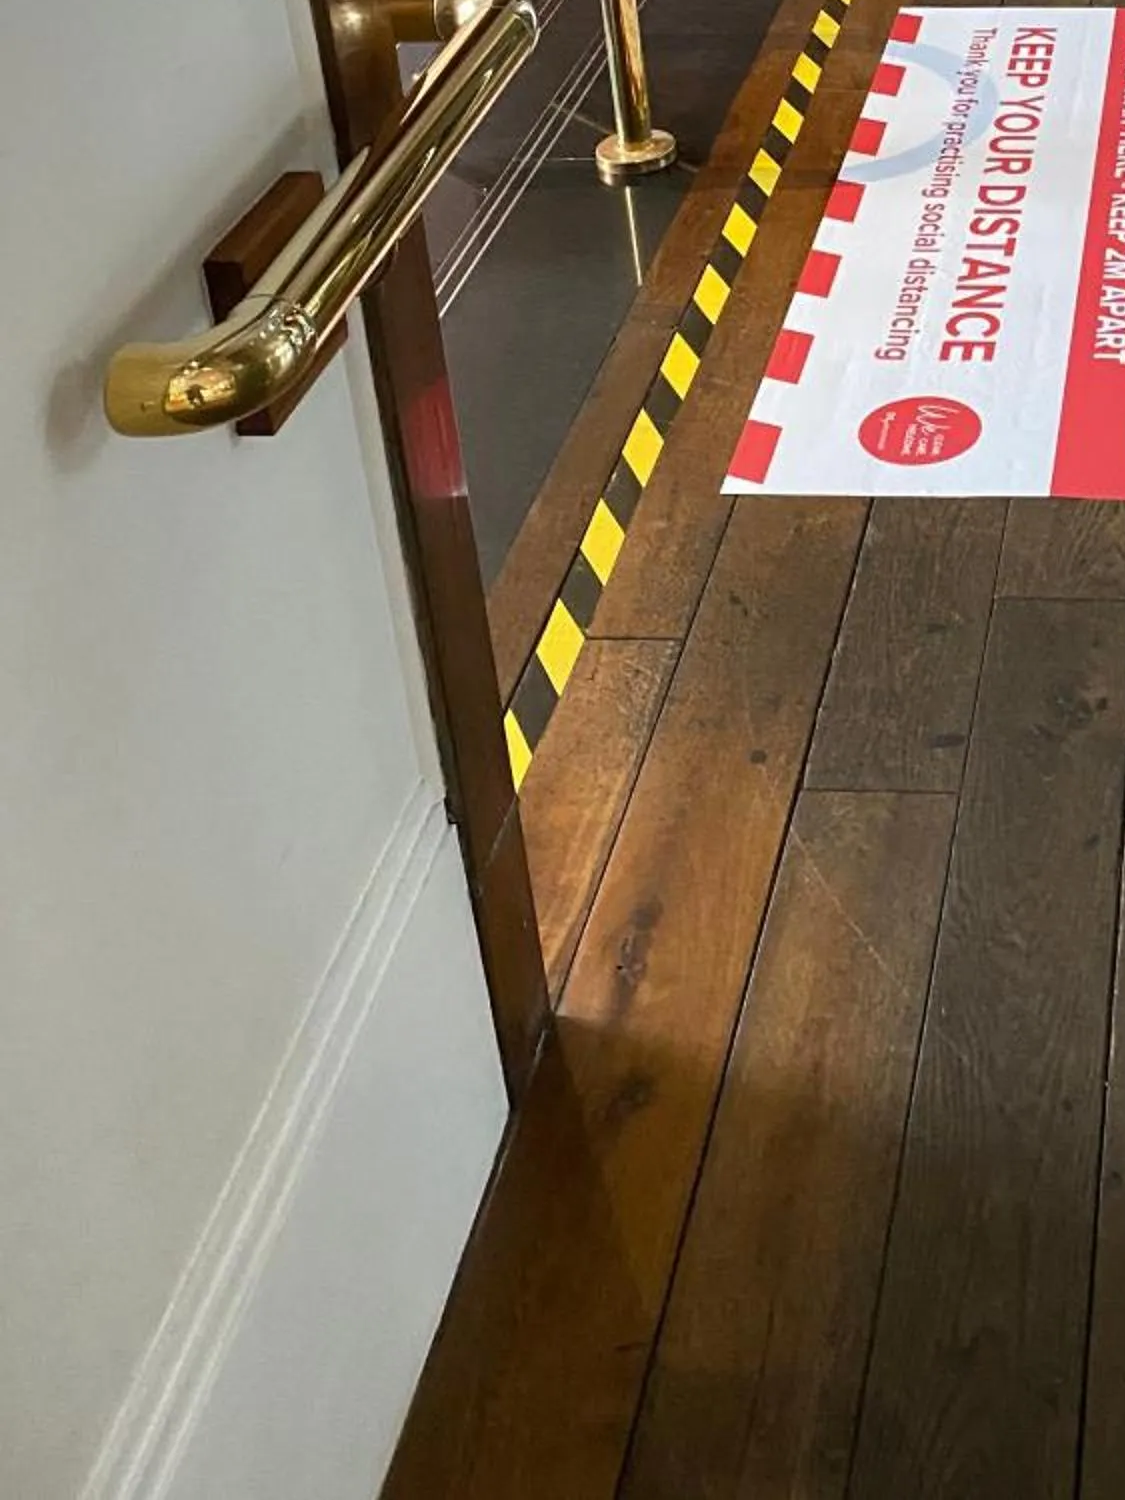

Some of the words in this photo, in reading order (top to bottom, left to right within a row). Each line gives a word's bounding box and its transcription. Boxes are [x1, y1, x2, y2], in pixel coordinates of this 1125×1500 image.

[963, 27, 998, 67] Thank
[1006, 27, 1057, 88] KEEP
[952, 99, 979, 118] for
[956, 68, 981, 95] you
[922, 121, 967, 198] practising
[984, 95, 1045, 175] YOUR
[912, 203, 946, 253] social
[939, 185, 1027, 362] DISTANCE
[874, 258, 937, 361] distancing
